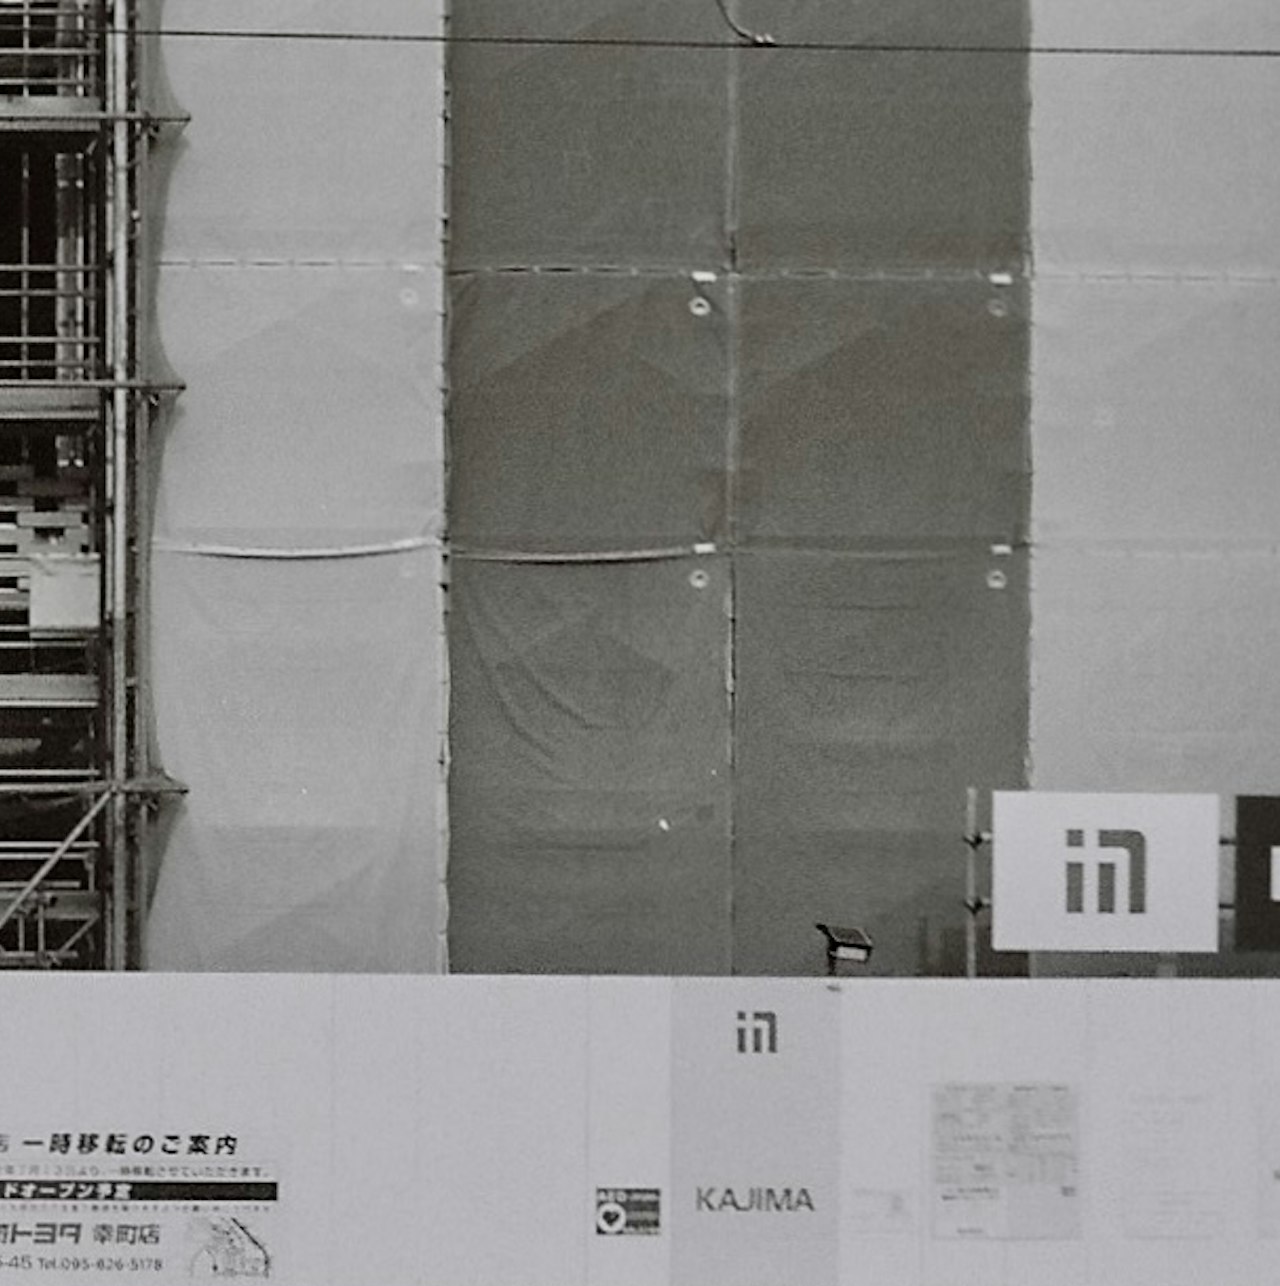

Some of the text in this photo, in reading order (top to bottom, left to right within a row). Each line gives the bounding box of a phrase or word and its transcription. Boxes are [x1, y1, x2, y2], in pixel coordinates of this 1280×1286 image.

[22, 1132, 238, 1155] 一時移転のご案内
[695, 1187, 815, 1212] KAJIMA
[91, 1223, 161, 1246] 幸町店
